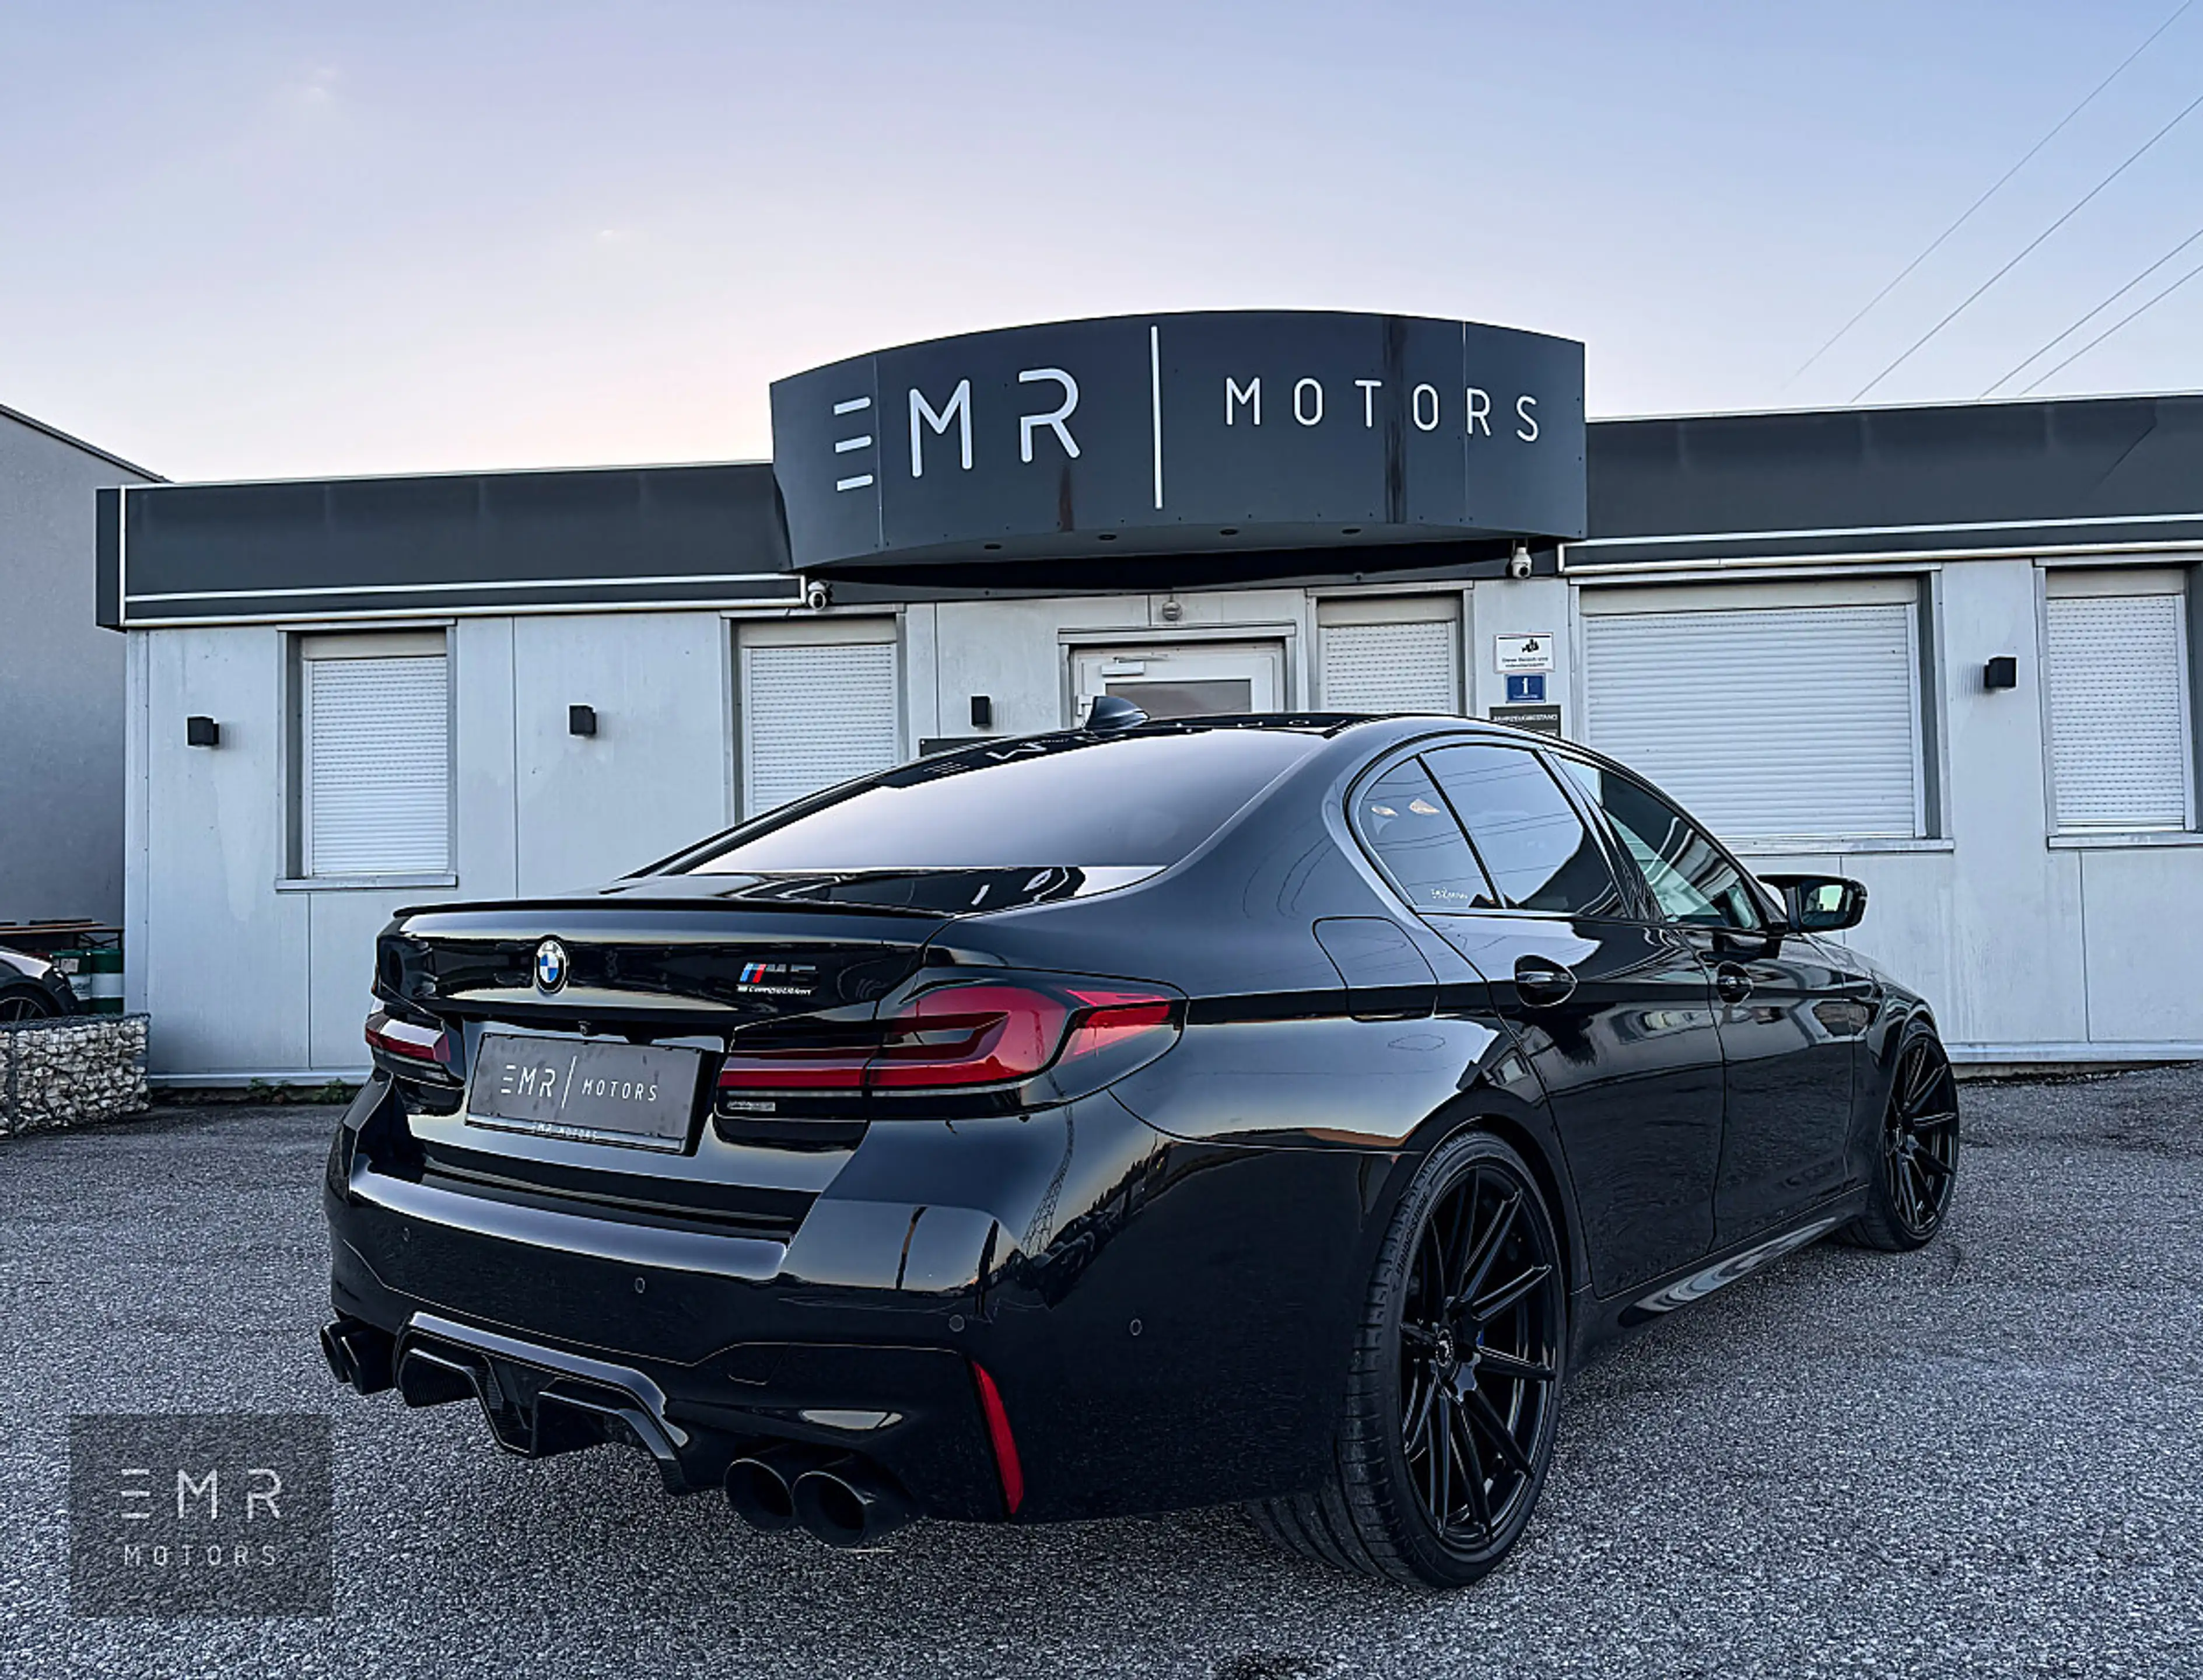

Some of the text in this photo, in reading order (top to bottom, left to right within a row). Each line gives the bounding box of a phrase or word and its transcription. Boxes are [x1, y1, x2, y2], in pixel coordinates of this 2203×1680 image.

[834, 368, 1539, 491] EMR MOTORS
[1522, 677, 1529, 695] 1
[500, 1065, 659, 1102] EMR MOTORS
